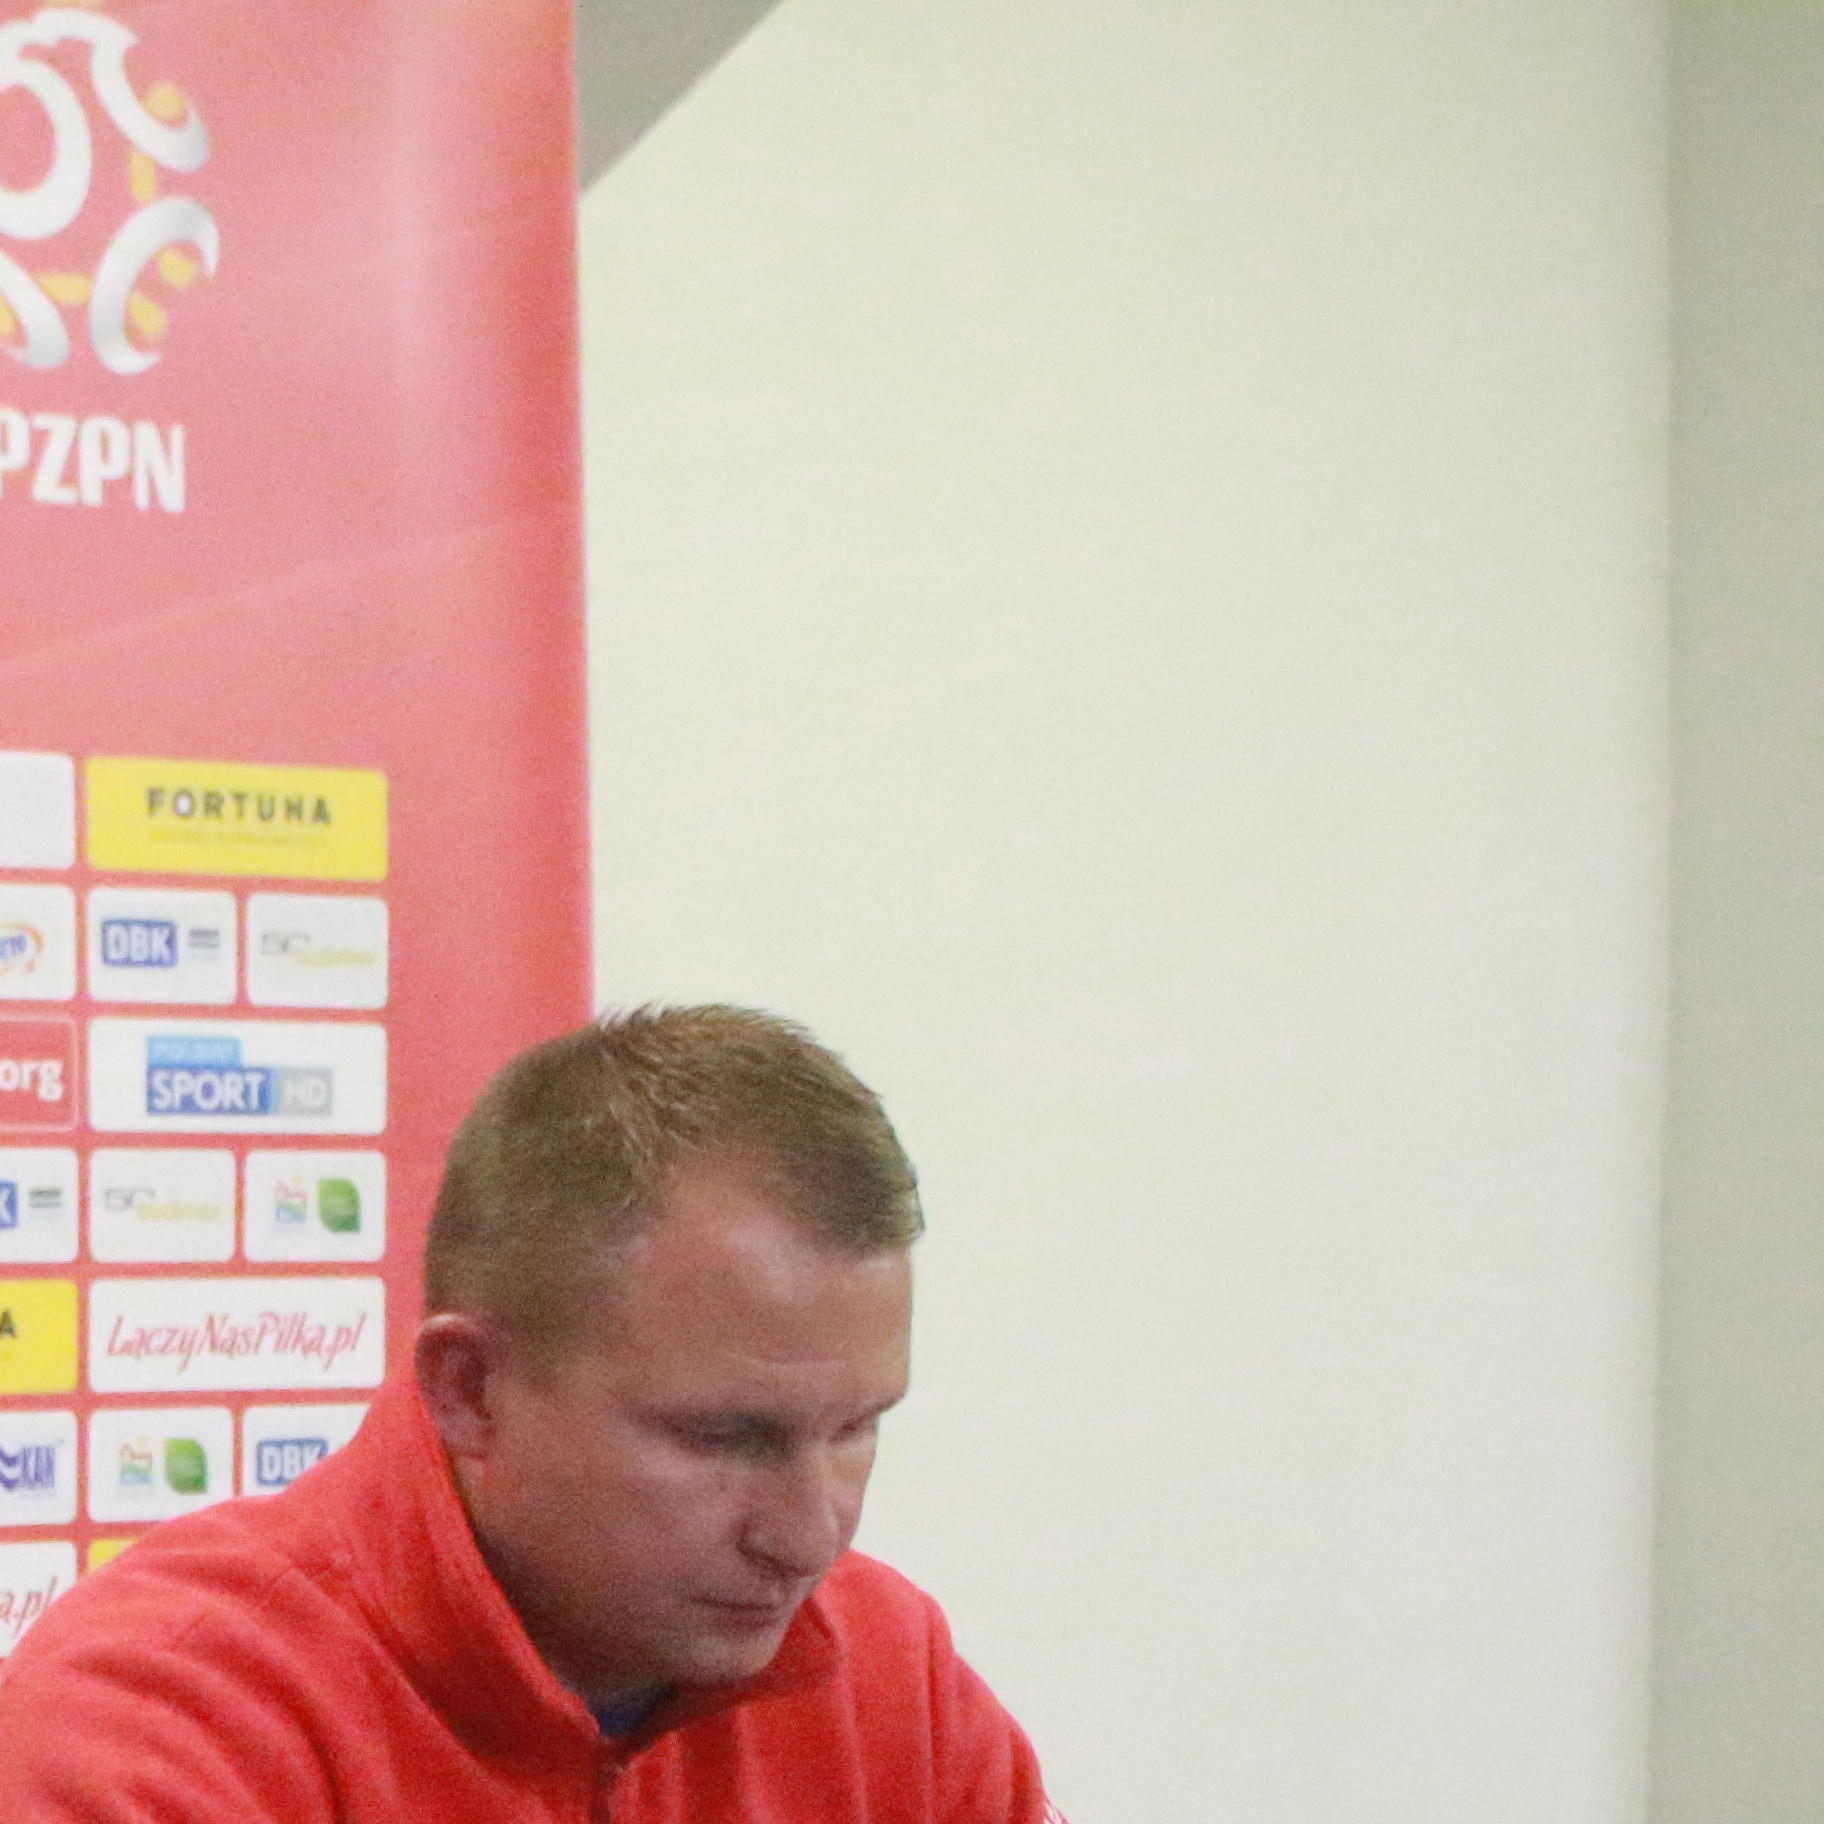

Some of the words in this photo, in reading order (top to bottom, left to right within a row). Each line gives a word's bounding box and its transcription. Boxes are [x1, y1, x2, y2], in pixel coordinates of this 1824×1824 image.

[144, 785, 334, 828] FORTUNA
[108, 922, 173, 965] DBK
[150, 1067, 266, 1116] SPORT
[284, 1072, 330, 1111] HD
